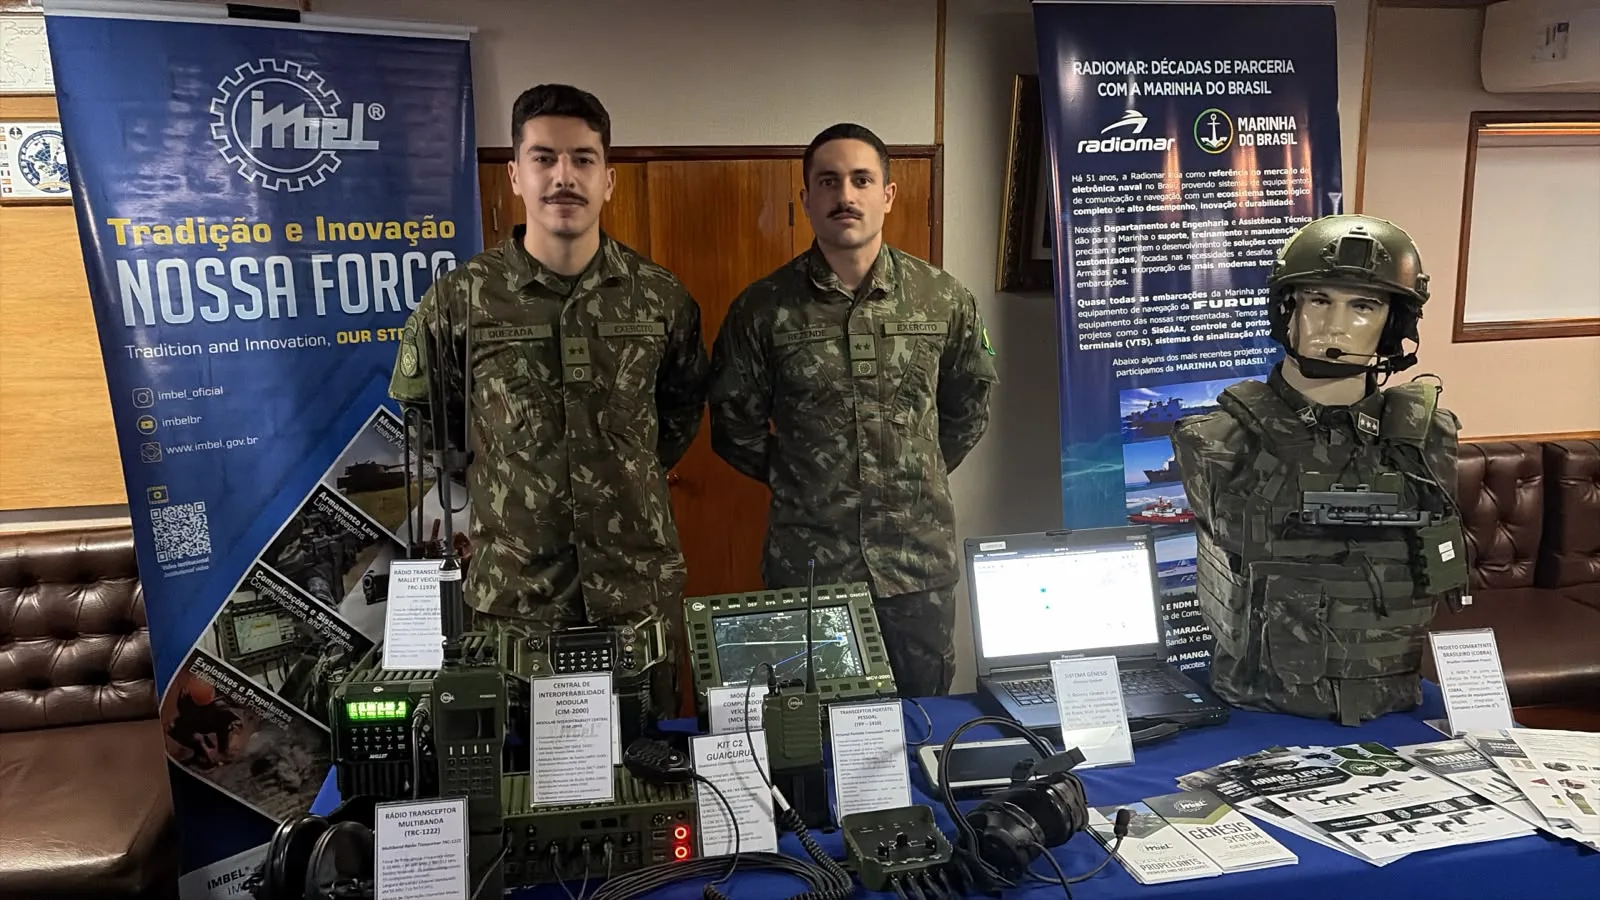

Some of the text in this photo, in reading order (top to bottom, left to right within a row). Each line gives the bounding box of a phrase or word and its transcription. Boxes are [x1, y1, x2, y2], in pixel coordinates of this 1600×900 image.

[1074, 58, 1295, 76] RADIOMAR: DÉCADAS DE PARCERIA
[1098, 80, 1271, 96] COM A MARINHA DO BRASIL
[1237, 116, 1296, 131] MARINHA
[1077, 137, 1175, 153] radiomar
[1239, 132, 1297, 147] DO BRASIL
[1071, 172, 1164, 183] Há Radiomar
[1072, 183, 1142, 194] eletrônica naval
[1085, 194, 1133, 204] comunicação
[1073, 207, 1113, 216] completo
[1146, 203, 1197, 211] desempenho,
[1201, 200, 1237, 209] inovação
[1245, 199, 1295, 208] durabilidade.
[1104, 222, 1168, 232] Departamentos
[1182, 220, 1228, 230] Engenharia
[1239, 217, 1281, 225] Assistência
[107, 214, 456, 252] Tradição e Inovação
[1119, 233, 1148, 242] Marinha
[1158, 232, 1189, 241] suporte,
[1192, 229, 1242, 238] treinamento
[1234, 238, 1265, 246] soluções
[1076, 248, 1273, 266] customizadas, focadas desafios
[1076, 260, 1256, 277] Armadas incorporação mais modernas
[116, 256, 297, 326] NOSSA
[1077, 278, 1128, 288] embarcações.
[1078, 288, 1254, 308] Quase todas embarcações Marinha
[1078, 297, 1269, 318] equipamento navegação FURUN
[1079, 320, 1130, 329] equipamento
[1176, 312, 1232, 322] representadas.
[489, 328, 533, 337] QUEZADA
[787, 330, 826, 341] REZENDE
[1079, 332, 1111, 341] projetos
[1152, 326, 1186, 334] SisGAAz,
[1191, 322, 1227, 331] controle
[1246, 320, 1270, 328] portos
[124, 342, 202, 359] Tradition
[208, 339, 238, 353] and
[245, 334, 331, 350] Innovation,
[337, 330, 372, 344] OUR
[1080, 341, 1122, 350] terminais
[1126, 338, 1152, 348] (VTS),
[1207, 330, 1253, 340] sinalização
[1142, 356, 1164, 364] alguns
[1181, 352, 1200, 360] mais
[1234, 348, 1262, 356] projetos
[1117, 366, 1163, 378] participamos
[1176, 362, 1217, 371] MARINHA
[1235, 357, 1266, 366] BRASIL!
[157, 386, 223, 400] imbel_oficial
[162, 416, 202, 427] imbelbr
[166, 436, 258, 455] www.imbel.gov.br
[313, 499, 365, 540] Light Weapons
[318, 491, 379, 539] Armamento Leve
[255, 570, 310, 611] Comunicações
[317, 613, 351, 640] Sistemas
[1173, 601, 1191, 609] NDM
[250, 577, 353, 652] Communication and Systems
[189, 664, 231, 694] Explosives
[195, 657, 292, 722] Explosivos Propelentes
[539, 689, 605, 698] INTEROPERABILIDADE
[555, 708, 589, 716] (CIM-2000)
[717, 740, 743, 749] KIT C2
[1251, 774, 1296, 786] ARMAS
[1294, 768, 1334, 778] LEVES
[410, 807, 456, 817] TRANSCEPTOR
[398, 818, 444, 827] MULTIBANDA
[1188, 821, 1253, 840] GÊNESIS
[405, 828, 440, 837] (TRC-1222)
[1223, 832, 1264, 844] SYSTEM
